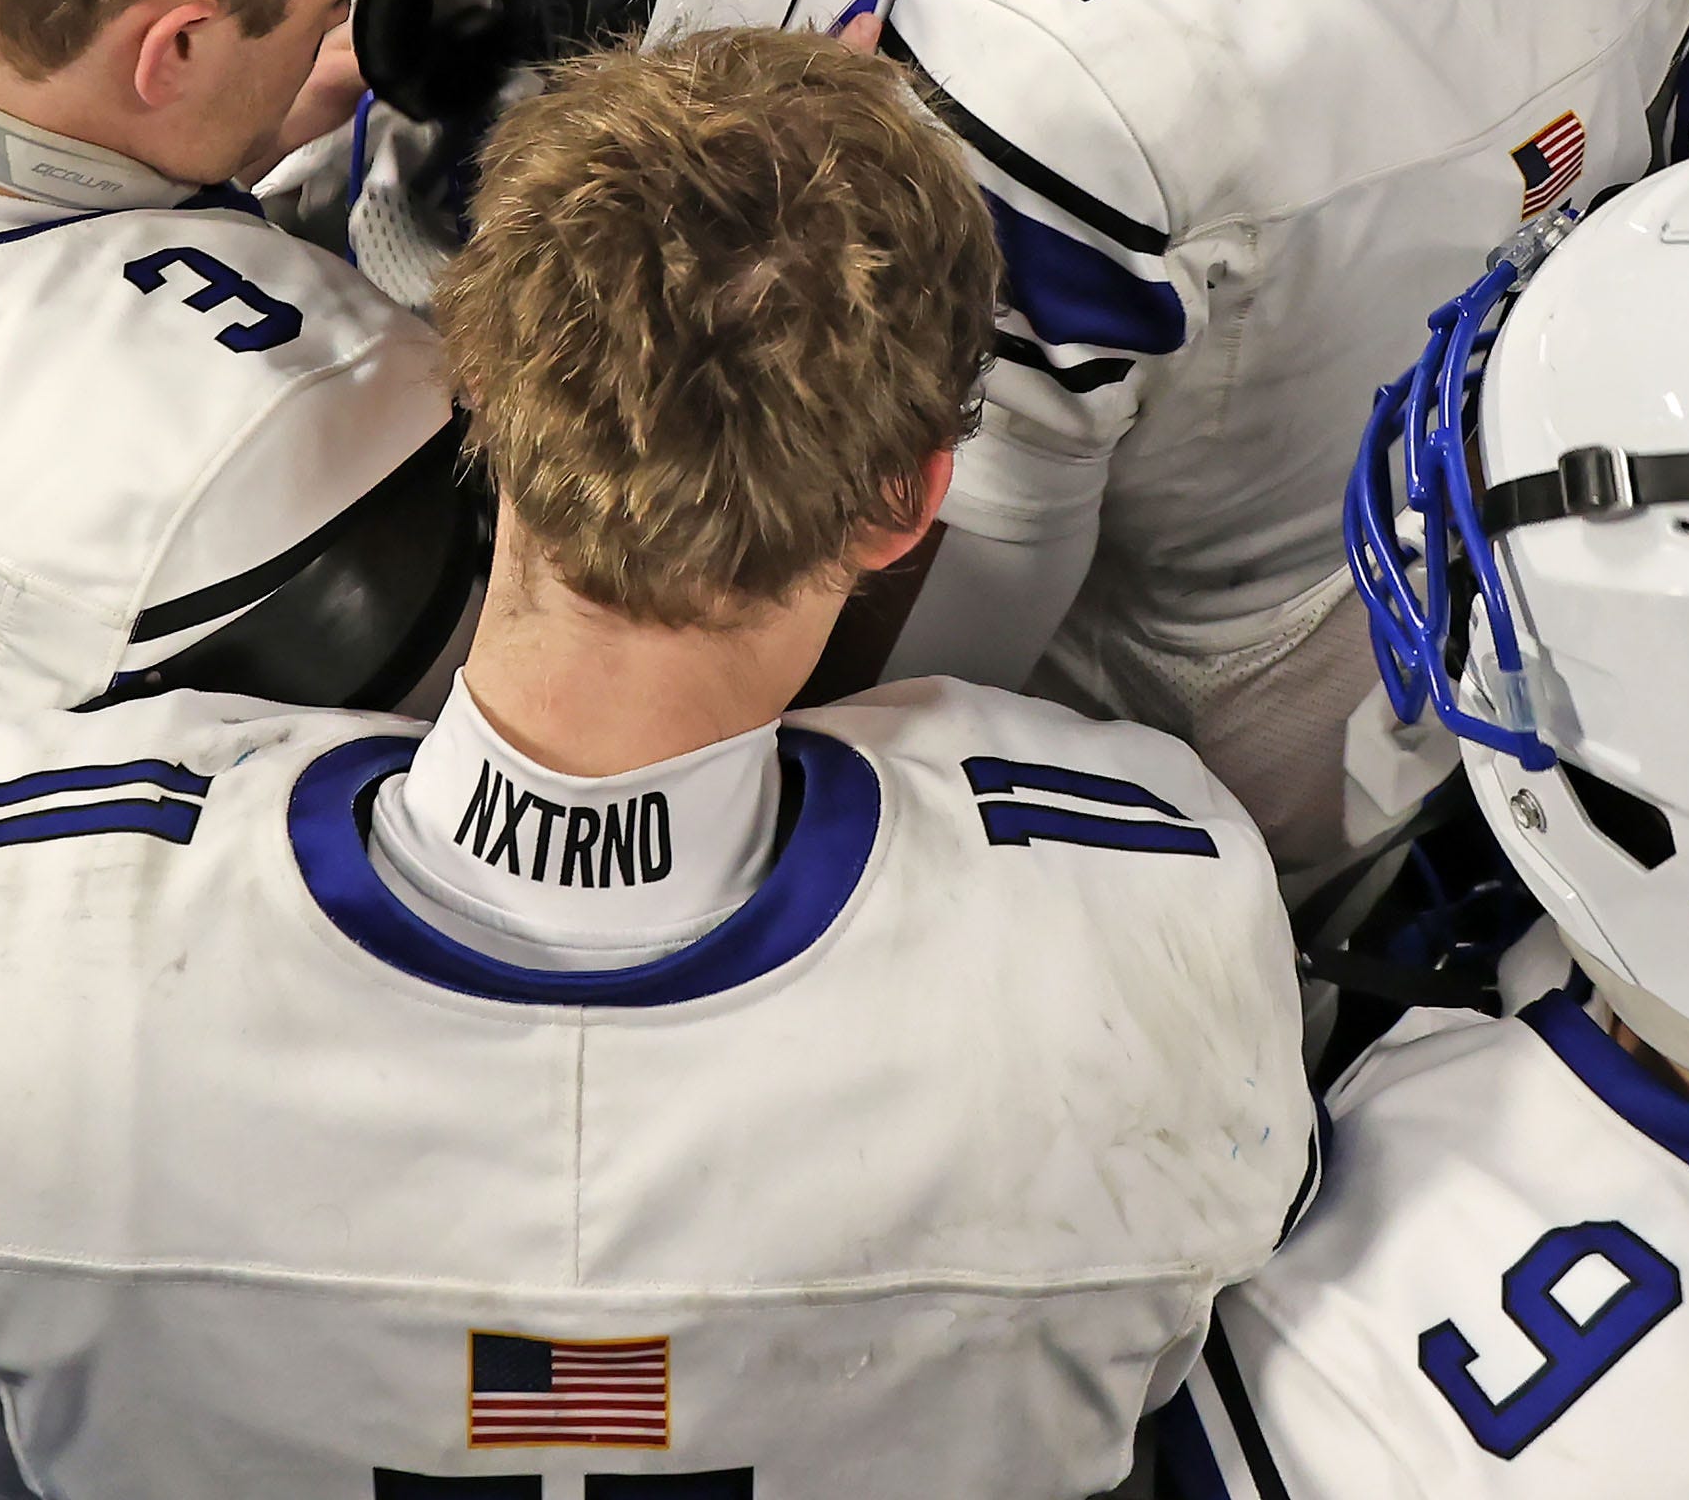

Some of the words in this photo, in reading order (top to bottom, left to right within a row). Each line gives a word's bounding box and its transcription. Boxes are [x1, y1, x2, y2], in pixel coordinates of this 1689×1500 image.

[123, 245, 305, 355] 3
[452, 757, 673, 889] NXTRND
[961, 754, 1220, 860] 11
[1417, 1218, 1684, 1463] 9
